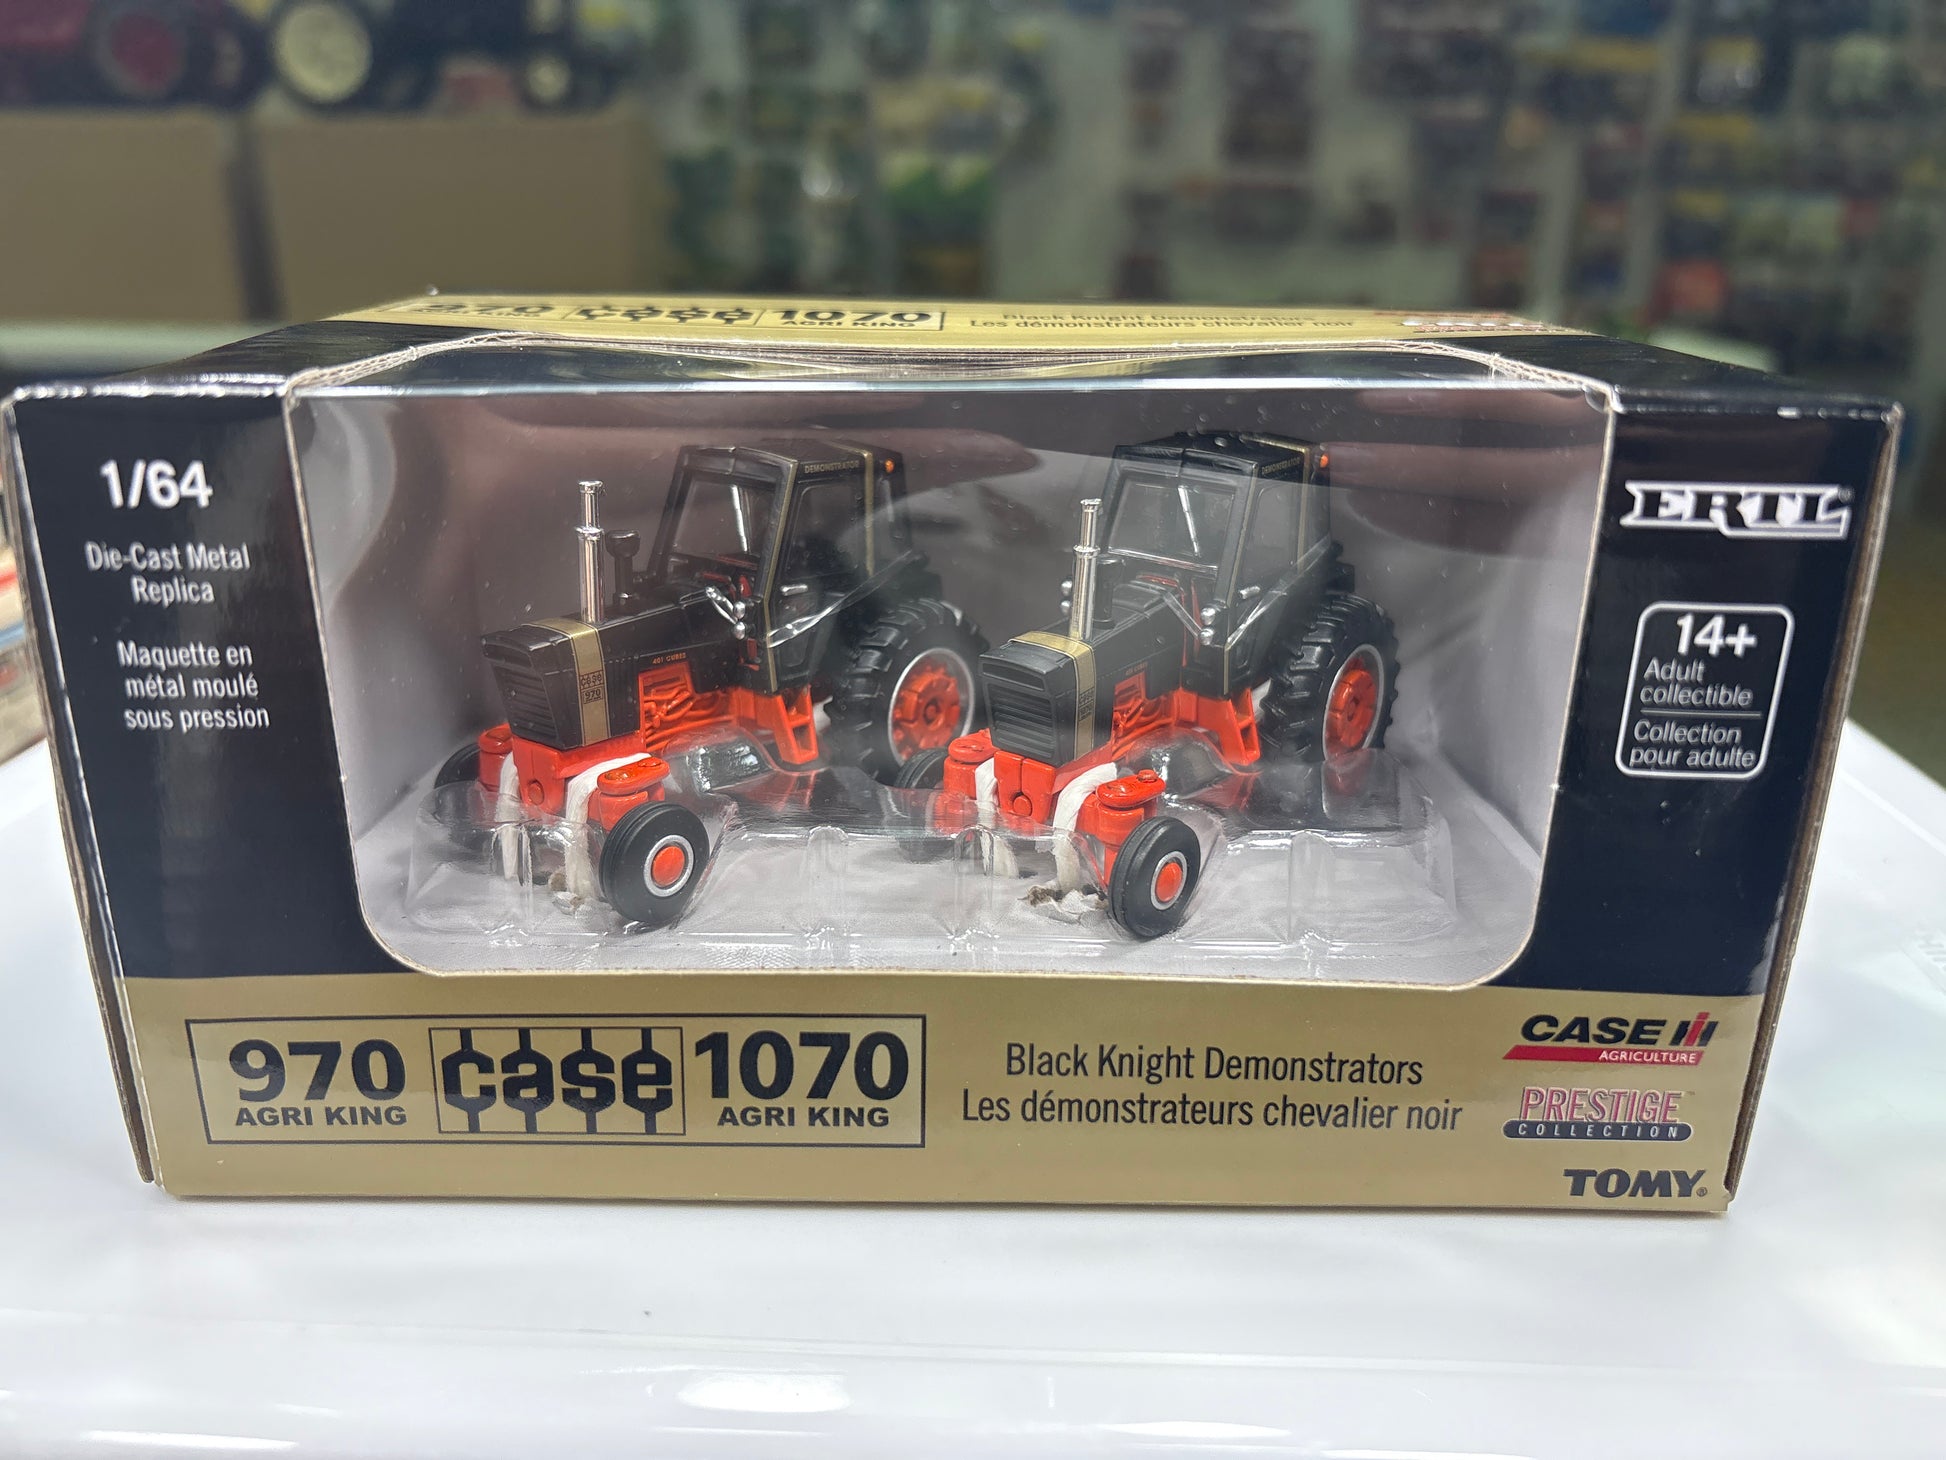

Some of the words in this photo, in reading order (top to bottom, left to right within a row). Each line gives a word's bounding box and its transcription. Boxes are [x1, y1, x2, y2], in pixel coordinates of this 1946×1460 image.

[772, 309, 932, 323] 1070
[970, 319, 1009, 328] Les
[1015, 320, 1197, 328] démonstrateurs
[1202, 320, 1304, 328] chevalier
[1071, 314, 1145, 322] Knight
[804, 460, 860, 474] DEMONSTRATOR
[100, 459, 213, 509] 1/64
[1620, 480, 1851, 540] ERTL
[84, 541, 182, 572] Die-Cast
[186, 543, 251, 571] Metal
[130, 575, 215, 608] Replica
[1676, 612, 1758, 658] 14+
[116, 640, 221, 671] Maquette
[226, 645, 253, 667] en
[1643, 656, 1705, 683] Adult
[125, 671, 187, 698] métal
[192, 672, 259, 698] moulé
[584, 688, 602, 700] 970
[1639, 682, 1754, 708] collectible
[123, 707, 174, 730] sous
[179, 703, 271, 734] pression
[1632, 718, 1742, 746] Collection
[1628, 746, 1680, 768] pour
[1686, 745, 1757, 769] adulte
[1521, 1014, 1667, 1046] CASE
[228, 1037, 407, 1103] 970
[694, 1030, 910, 1101] 1070
[1005, 1042, 1089, 1077] Black
[1098, 1044, 1196, 1085] Knight
[1205, 1046, 1424, 1086] Demonstrators
[1598, 1050, 1697, 1064] AGRICULTURE
[441, 1028, 674, 1134] case
[235, 1106, 314, 1128] AGRI
[325, 1105, 408, 1128] KING
[717, 1106, 797, 1128] AGRI
[807, 1106, 891, 1128] KING
[961, 1088, 1011, 1122] Les
[1020, 1090, 1254, 1126] démonstrateurs
[1262, 1095, 1399, 1129] chevalier
[1405, 1098, 1464, 1131] noir
[1519, 1086, 1683, 1124] PRESTIGE
[1517, 1122, 1679, 1138] COLLECTION
[1562, 1168, 1708, 1198] TOMY
